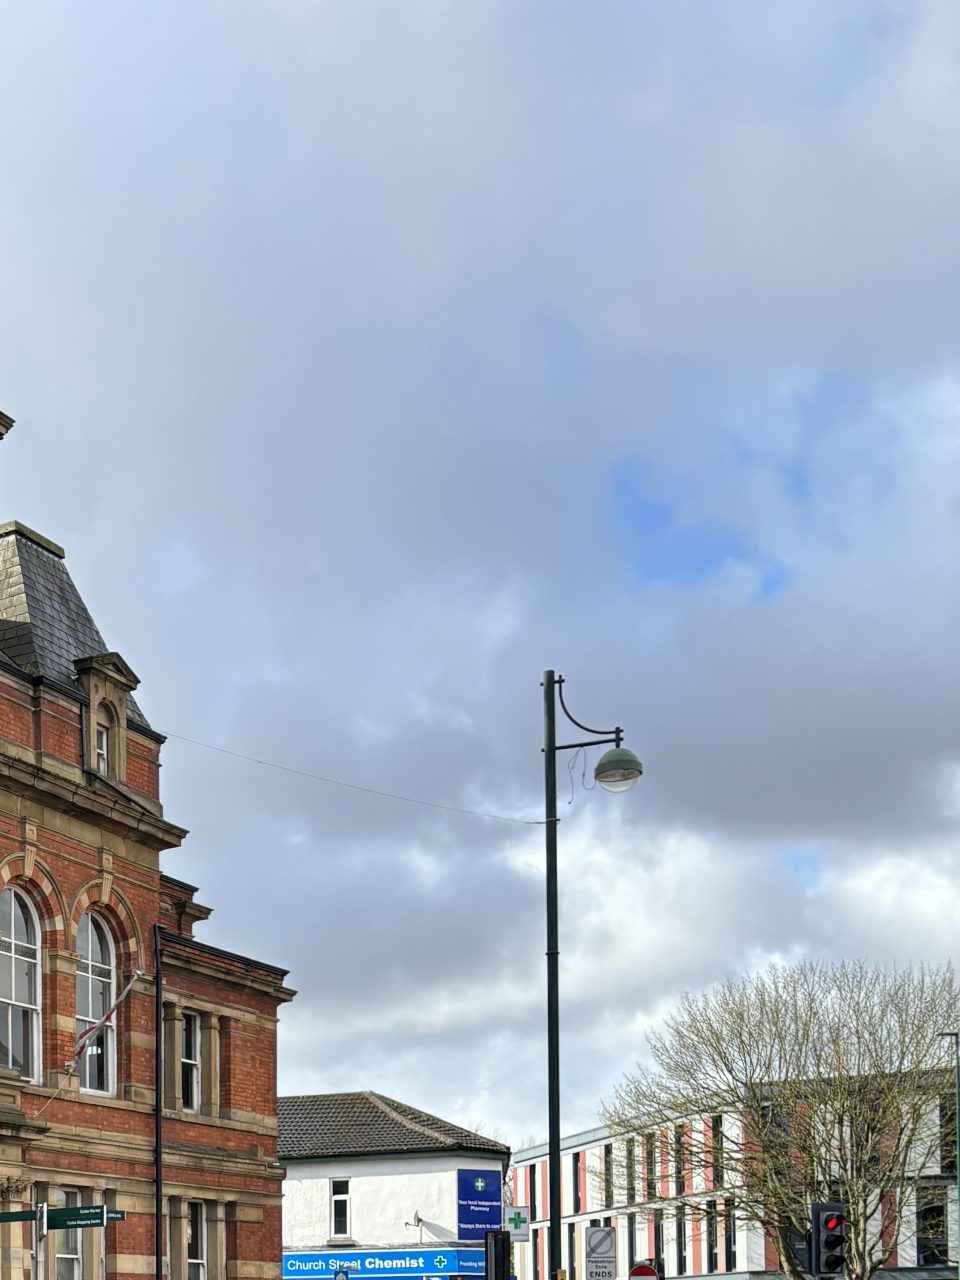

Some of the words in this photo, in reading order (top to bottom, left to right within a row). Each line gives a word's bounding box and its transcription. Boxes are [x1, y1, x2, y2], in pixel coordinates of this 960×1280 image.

[287, 1260, 326, 1271] Church
[328, 1259, 362, 1271] Street
[364, 1257, 425, 1269] Chemist
